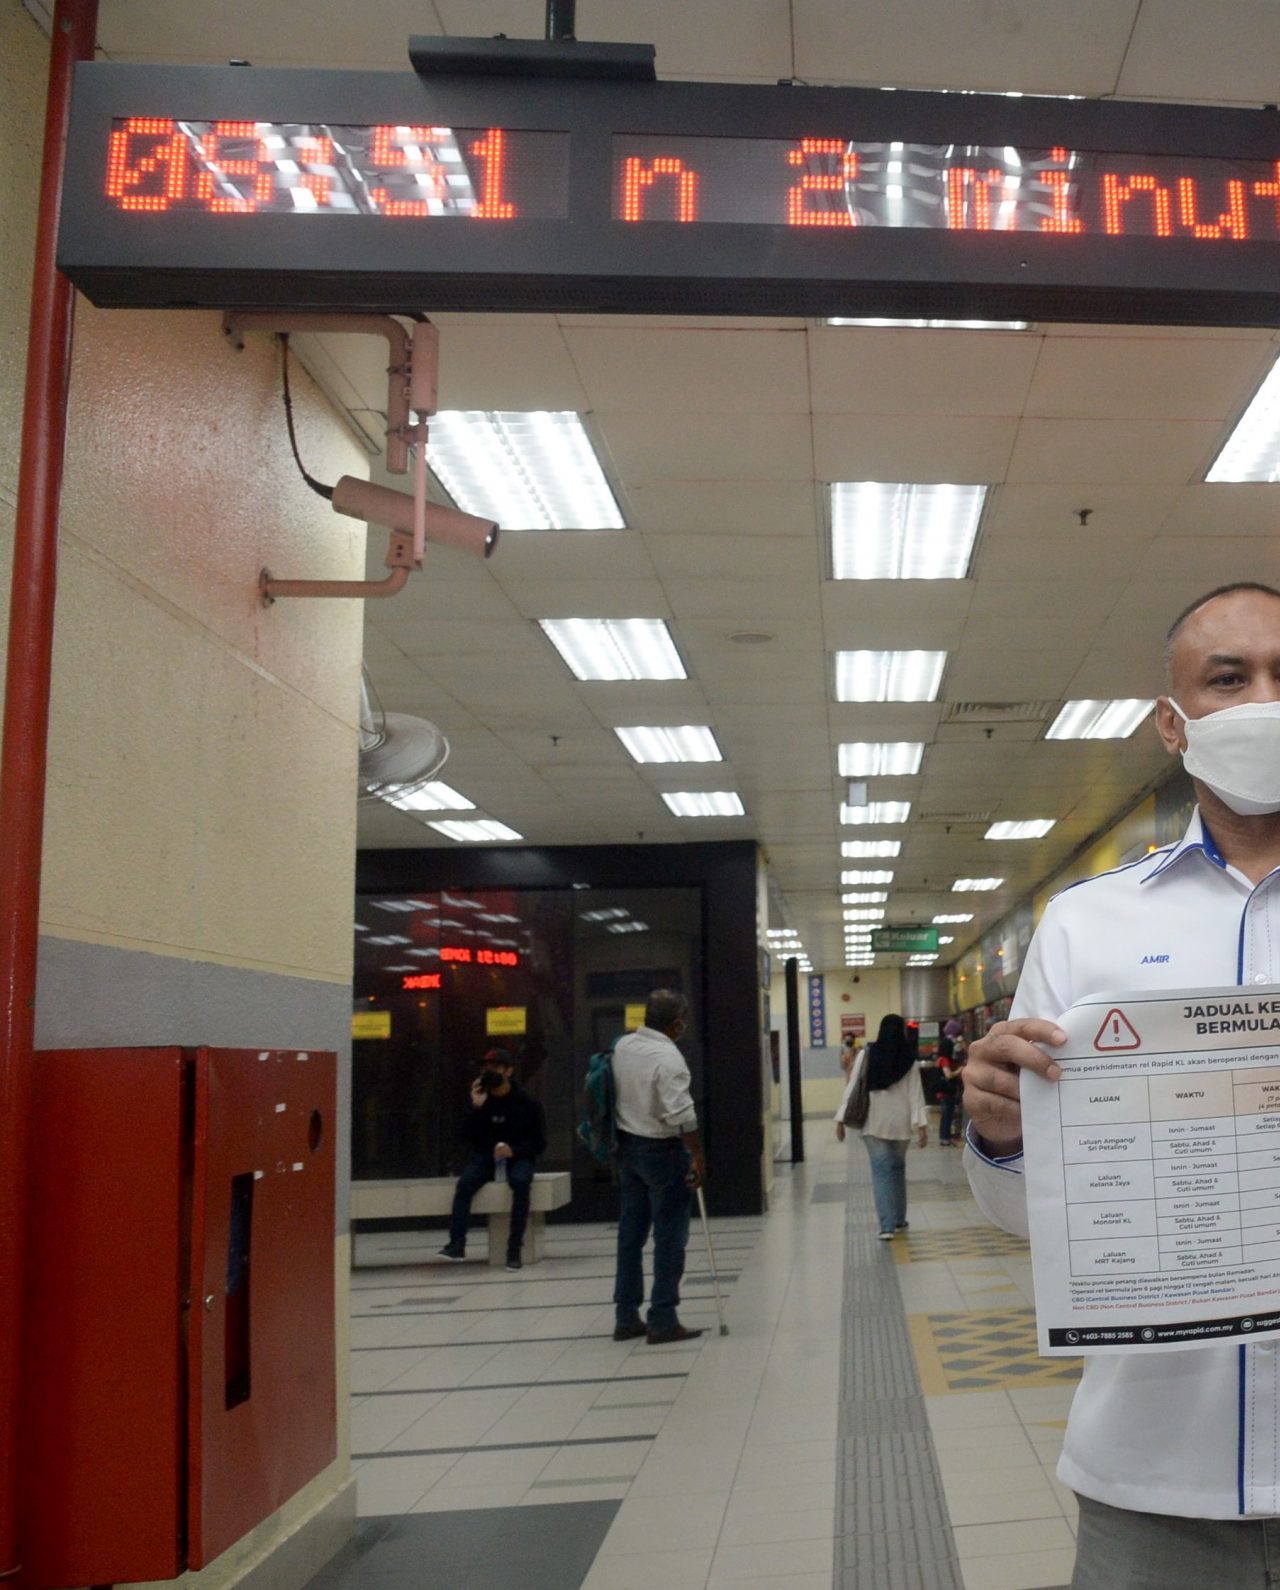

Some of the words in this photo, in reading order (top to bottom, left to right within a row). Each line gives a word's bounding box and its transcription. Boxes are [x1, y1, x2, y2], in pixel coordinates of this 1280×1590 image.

[105, 117, 514, 219] 08:51
[622, 157, 697, 222] n
[789, 137, 858, 226] 2
[1140, 954, 1170, 965] AMIR
[1183, 1004, 1254, 1019] JADUAL
[1083, 1063, 1138, 1073] perkhidmatan
[1151, 1060, 1173, 1069] Rapid
[1208, 1055, 1249, 1065] beroperasi
[1250, 1053, 1279, 1062] dengan
[1089, 1096, 1120, 1104] LALUAN
[1175, 1091, 1205, 1099] WAKTU
[1158, 1325, 1233, 1338] www.myrapid.com.my
